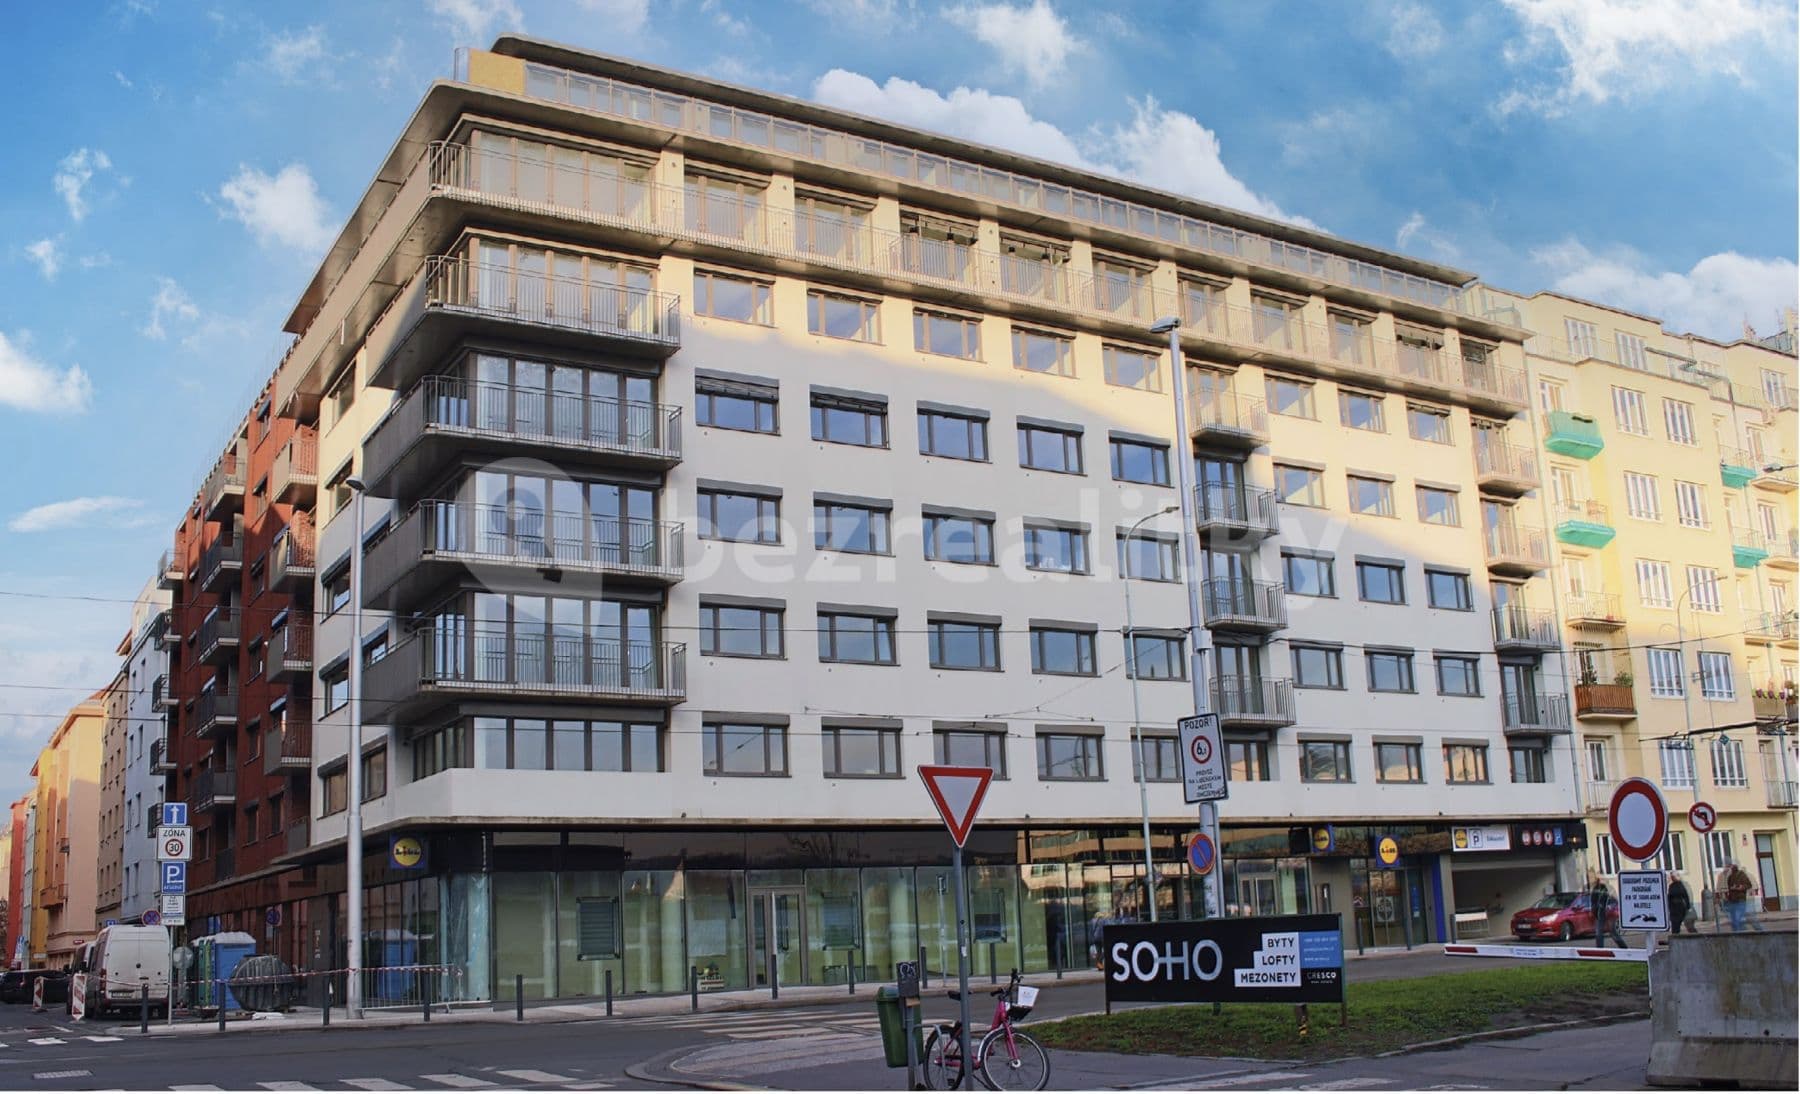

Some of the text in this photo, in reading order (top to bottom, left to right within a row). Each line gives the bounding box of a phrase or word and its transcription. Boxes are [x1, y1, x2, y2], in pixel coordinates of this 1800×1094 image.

[1184, 717, 1213, 731] POZOR!
[168, 843, 180, 852] 30
[1267, 937, 1294, 948] BYTY
[1112, 939, 1223, 982] SOHO
[1262, 954, 1296, 966] LOFTY
[1240, 971, 1297, 983] MEZONETY
[1306, 971, 1337, 980] CRESCO
